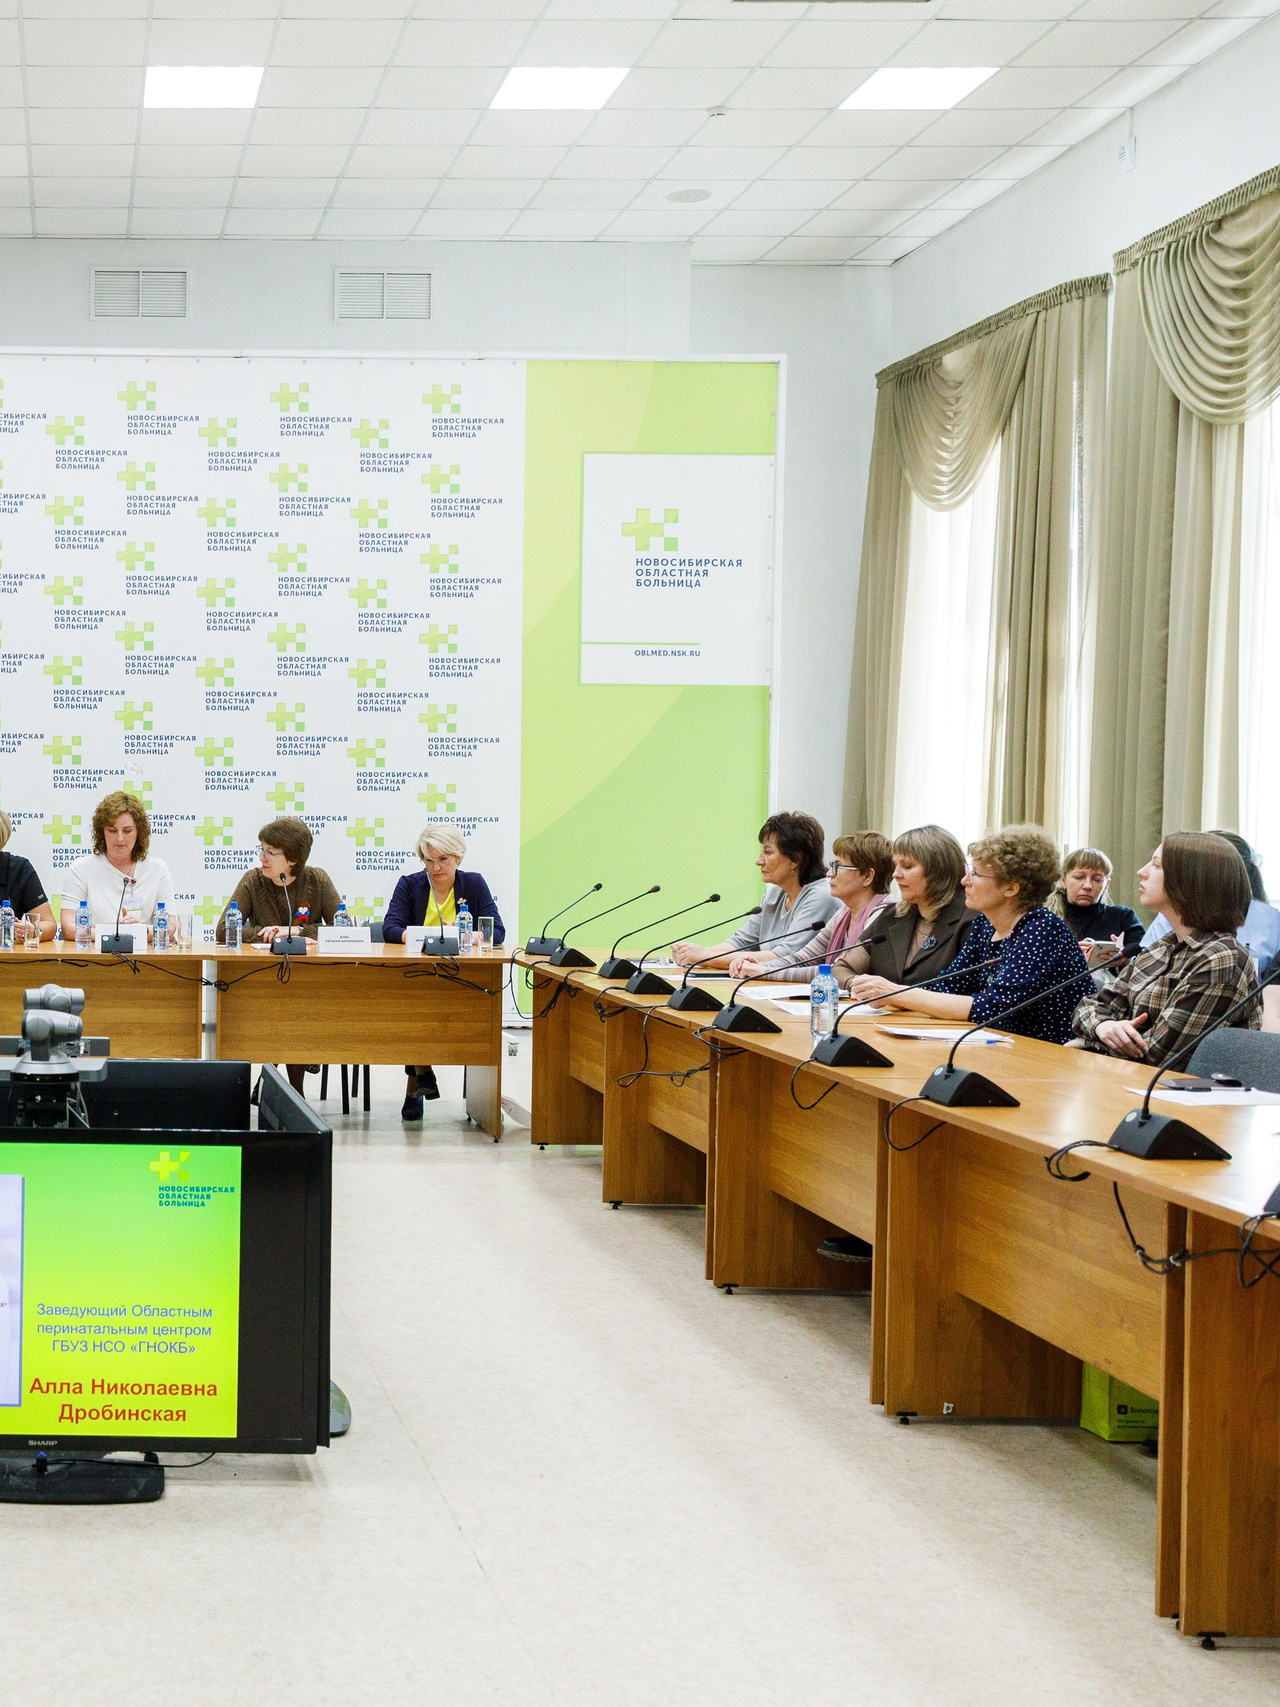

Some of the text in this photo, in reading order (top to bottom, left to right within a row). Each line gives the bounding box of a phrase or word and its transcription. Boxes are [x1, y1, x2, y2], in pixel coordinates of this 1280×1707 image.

[126, 414, 199, 422] НОВОСИБИРСКАЯ
[279, 415, 352, 423] НОВОСИБИРСКАЯ
[431, 417, 504, 425] НОВОСИБИРСКАЯ
[126, 421, 176, 429] ОБЛАСТНАЯ
[279, 422, 329, 430] ОБЛАСТНАЯ
[431, 424, 481, 432] ОБЛАСТНАЯ
[55, 449, 128, 457] НОВОСИБИРСКАЯ
[207, 451, 280, 459] НОВОСИБИРСКАЯ
[359, 452, 432, 460] НОВОСИБИРСКАЯ
[55, 456, 105, 464] ОБЛАСТНАЯ
[207, 458, 257, 466] ОБЛАСТНАЯ
[359, 459, 409, 467] ОБЛАСТНАЯ
[126, 494, 199, 502] НОВОСИБИРСКАЯ
[279, 496, 352, 504] НОВОСИБИРСКАЯ
[430, 497, 503, 505] НОВОСИБИРСКАЯ
[126, 501, 176, 509] ОБЛАСТНАЯ
[279, 503, 329, 511] ОБЛАСТНАЯ
[430, 504, 480, 512] ОБЛАСТНАЯ
[54, 529, 127, 537] НОВОСИБИРСКАЯ
[207, 531, 280, 539] НОВОСИБИРСКАЯ
[359, 532, 432, 540] НОВОСИБИРСКАЯ
[54, 536, 104, 544] ОБЛАСТНАЯ
[207, 538, 257, 546] ОБЛАСТНАЯ
[359, 539, 409, 547] ОБЛАСТНАЯ
[635, 558, 743, 568] НОВОСИБИРСКАЯ
[635, 568, 709, 578] ОБЛАСТНАЯ
[125, 574, 198, 582] НОВОСИБИРСКАЯ
[277, 576, 350, 584] НОВОСИБИРСКАЯ
[429, 577, 502, 585] НОВОСИБИРСКАЯ
[125, 581, 175, 589] ОБЛАСТНАЯ
[277, 583, 327, 591] ОБЛАСТНАЯ
[635, 578, 701, 589] БОЛЬНИЦА
[429, 584, 479, 592] ОБЛАСТНАЯ
[53, 609, 126, 617] НОВОСИБИРСКАЯ
[206, 610, 279, 618] НОВОСИБИРСКАЯ
[357, 612, 430, 620] НОВОСИБИРСКАЯ
[53, 616, 103, 624] ОБЛАСТНАЯ
[206, 617, 256, 625] ОБЛАСТНАЯ
[357, 619, 407, 627] ОБЛАСТНАЯ
[634, 649, 701, 658] OBLMED.NSK.RU
[124, 654, 197, 662] НОВОСИБИРСКАЯ
[276, 655, 349, 663] НОВОСИБИРСКАЯ
[428, 657, 501, 665] НОВОСИБИРСКАЯ
[124, 661, 174, 669] ОБЛАСТНАЯ
[276, 662, 326, 670] ОБЛАСТНАЯ
[428, 664, 478, 672] ОБЛАСТНАЯ
[52, 688, 125, 696] НОВОСИБИРСКАЯ
[204, 690, 277, 698] НОВОСИБИРСКАЯ
[356, 691, 429, 699] НОВОСИБИРСКАЯ
[52, 695, 102, 703] ОБЛАСТНАЯ
[204, 697, 254, 705] ОБЛАСТНАЯ
[356, 698, 406, 706] ОБЛАСТНАЯ
[123, 734, 196, 742] НОВОСИБИРСКАЯ
[275, 735, 348, 743] НОВОСИБИРСКАЯ
[427, 736, 500, 744] НОВОСИБИРСКАЯ
[123, 741, 173, 749] ОБЛАСТНАЯ
[275, 742, 325, 750] ОБЛАСТНАЯ
[427, 743, 477, 751] ОБЛАСТНАЯ
[52, 768, 125, 776] НОВОСИБИРСКАЯ
[204, 770, 277, 778] НОВОСИБИРСКАЯ
[356, 771, 429, 779] НОВОСИБИРСКАЯ
[52, 775, 102, 783] ОБЛАСТНАЯ
[204, 777, 254, 785] ОБЛАСТНАЯ
[356, 778, 406, 786] ОБЛАСТНАЯ
[204, 849, 258, 857] НОВОСИБИРС
[355, 850, 417, 858] НОВОСИБИРСК
[204, 856, 254, 864] ОБЛАСТНАЯ
[355, 857, 405, 865] ОБЛАСТНАЯ
[204, 863, 249, 871] БОЛЬНИЦА
[355, 864, 401, 872] БОЛЬНИЦА
[158, 1185, 236, 1194] НОВОСИБИРСКАЯ
[158, 1192, 212, 1201] ОБЛАСТНАЯ
[158, 1200, 206, 1208] БОЛЬНИЦА
[37, 1303, 213, 1319] Заведующий Областным
[37, 1324, 212, 1339] перинатальным центром
[52, 1339, 196, 1354] ГБУЗ НСО «ГНОКБ»
[29, 1377, 218, 1397] Алла Николаевна
[58, 1403, 187, 1425] Дробинская
